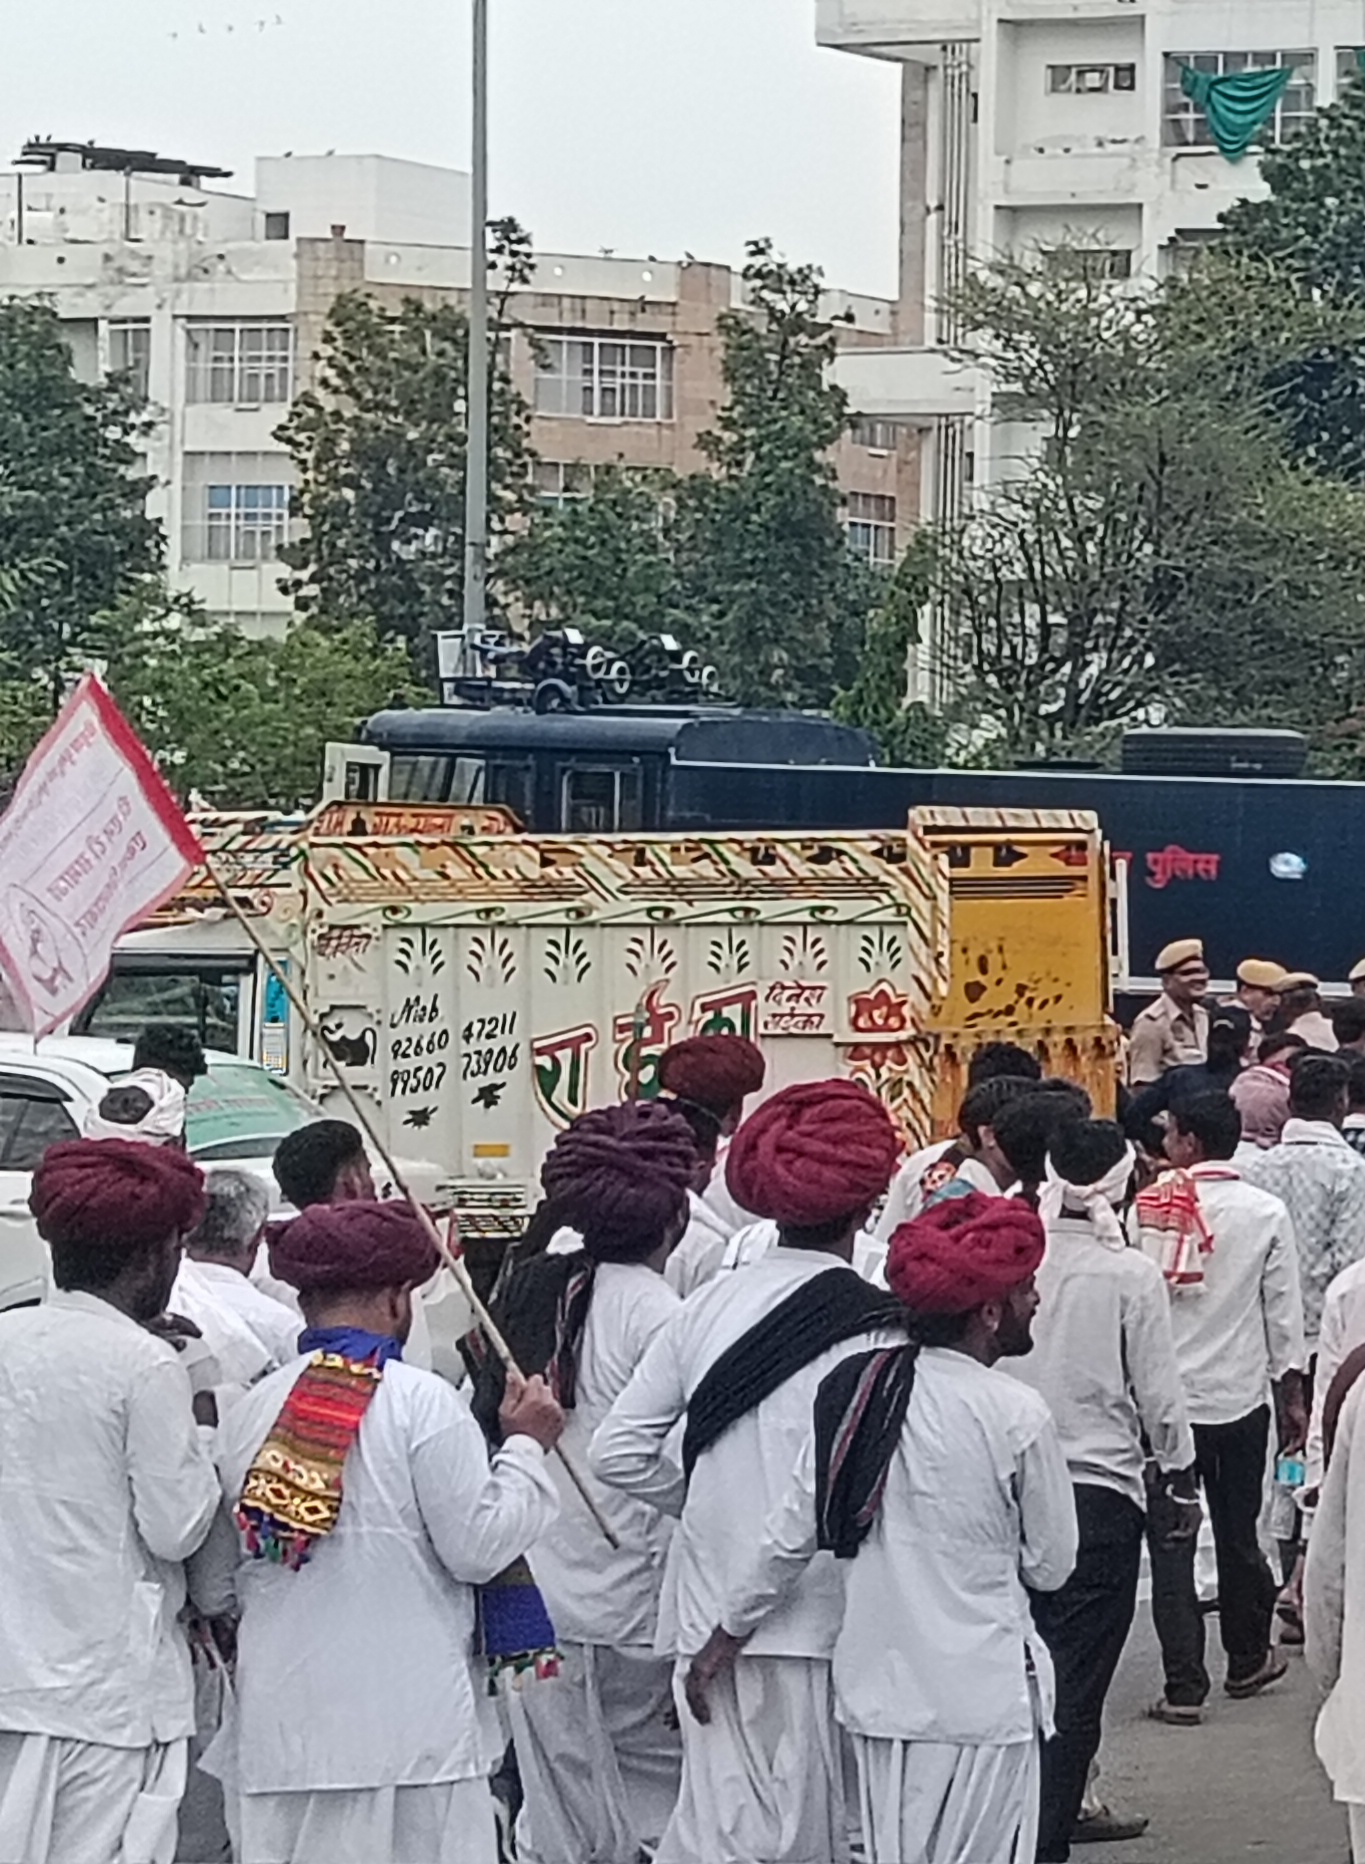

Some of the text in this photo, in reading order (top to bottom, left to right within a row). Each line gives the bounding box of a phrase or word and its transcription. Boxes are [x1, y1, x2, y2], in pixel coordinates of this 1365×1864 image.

[1145, 844, 1220, 888] पुलिस
[764, 979, 828, 1007] दिनेश
[391, 1011, 517, 1060] 92660 47211
[390, 1043, 520, 1098] 99507 73906
